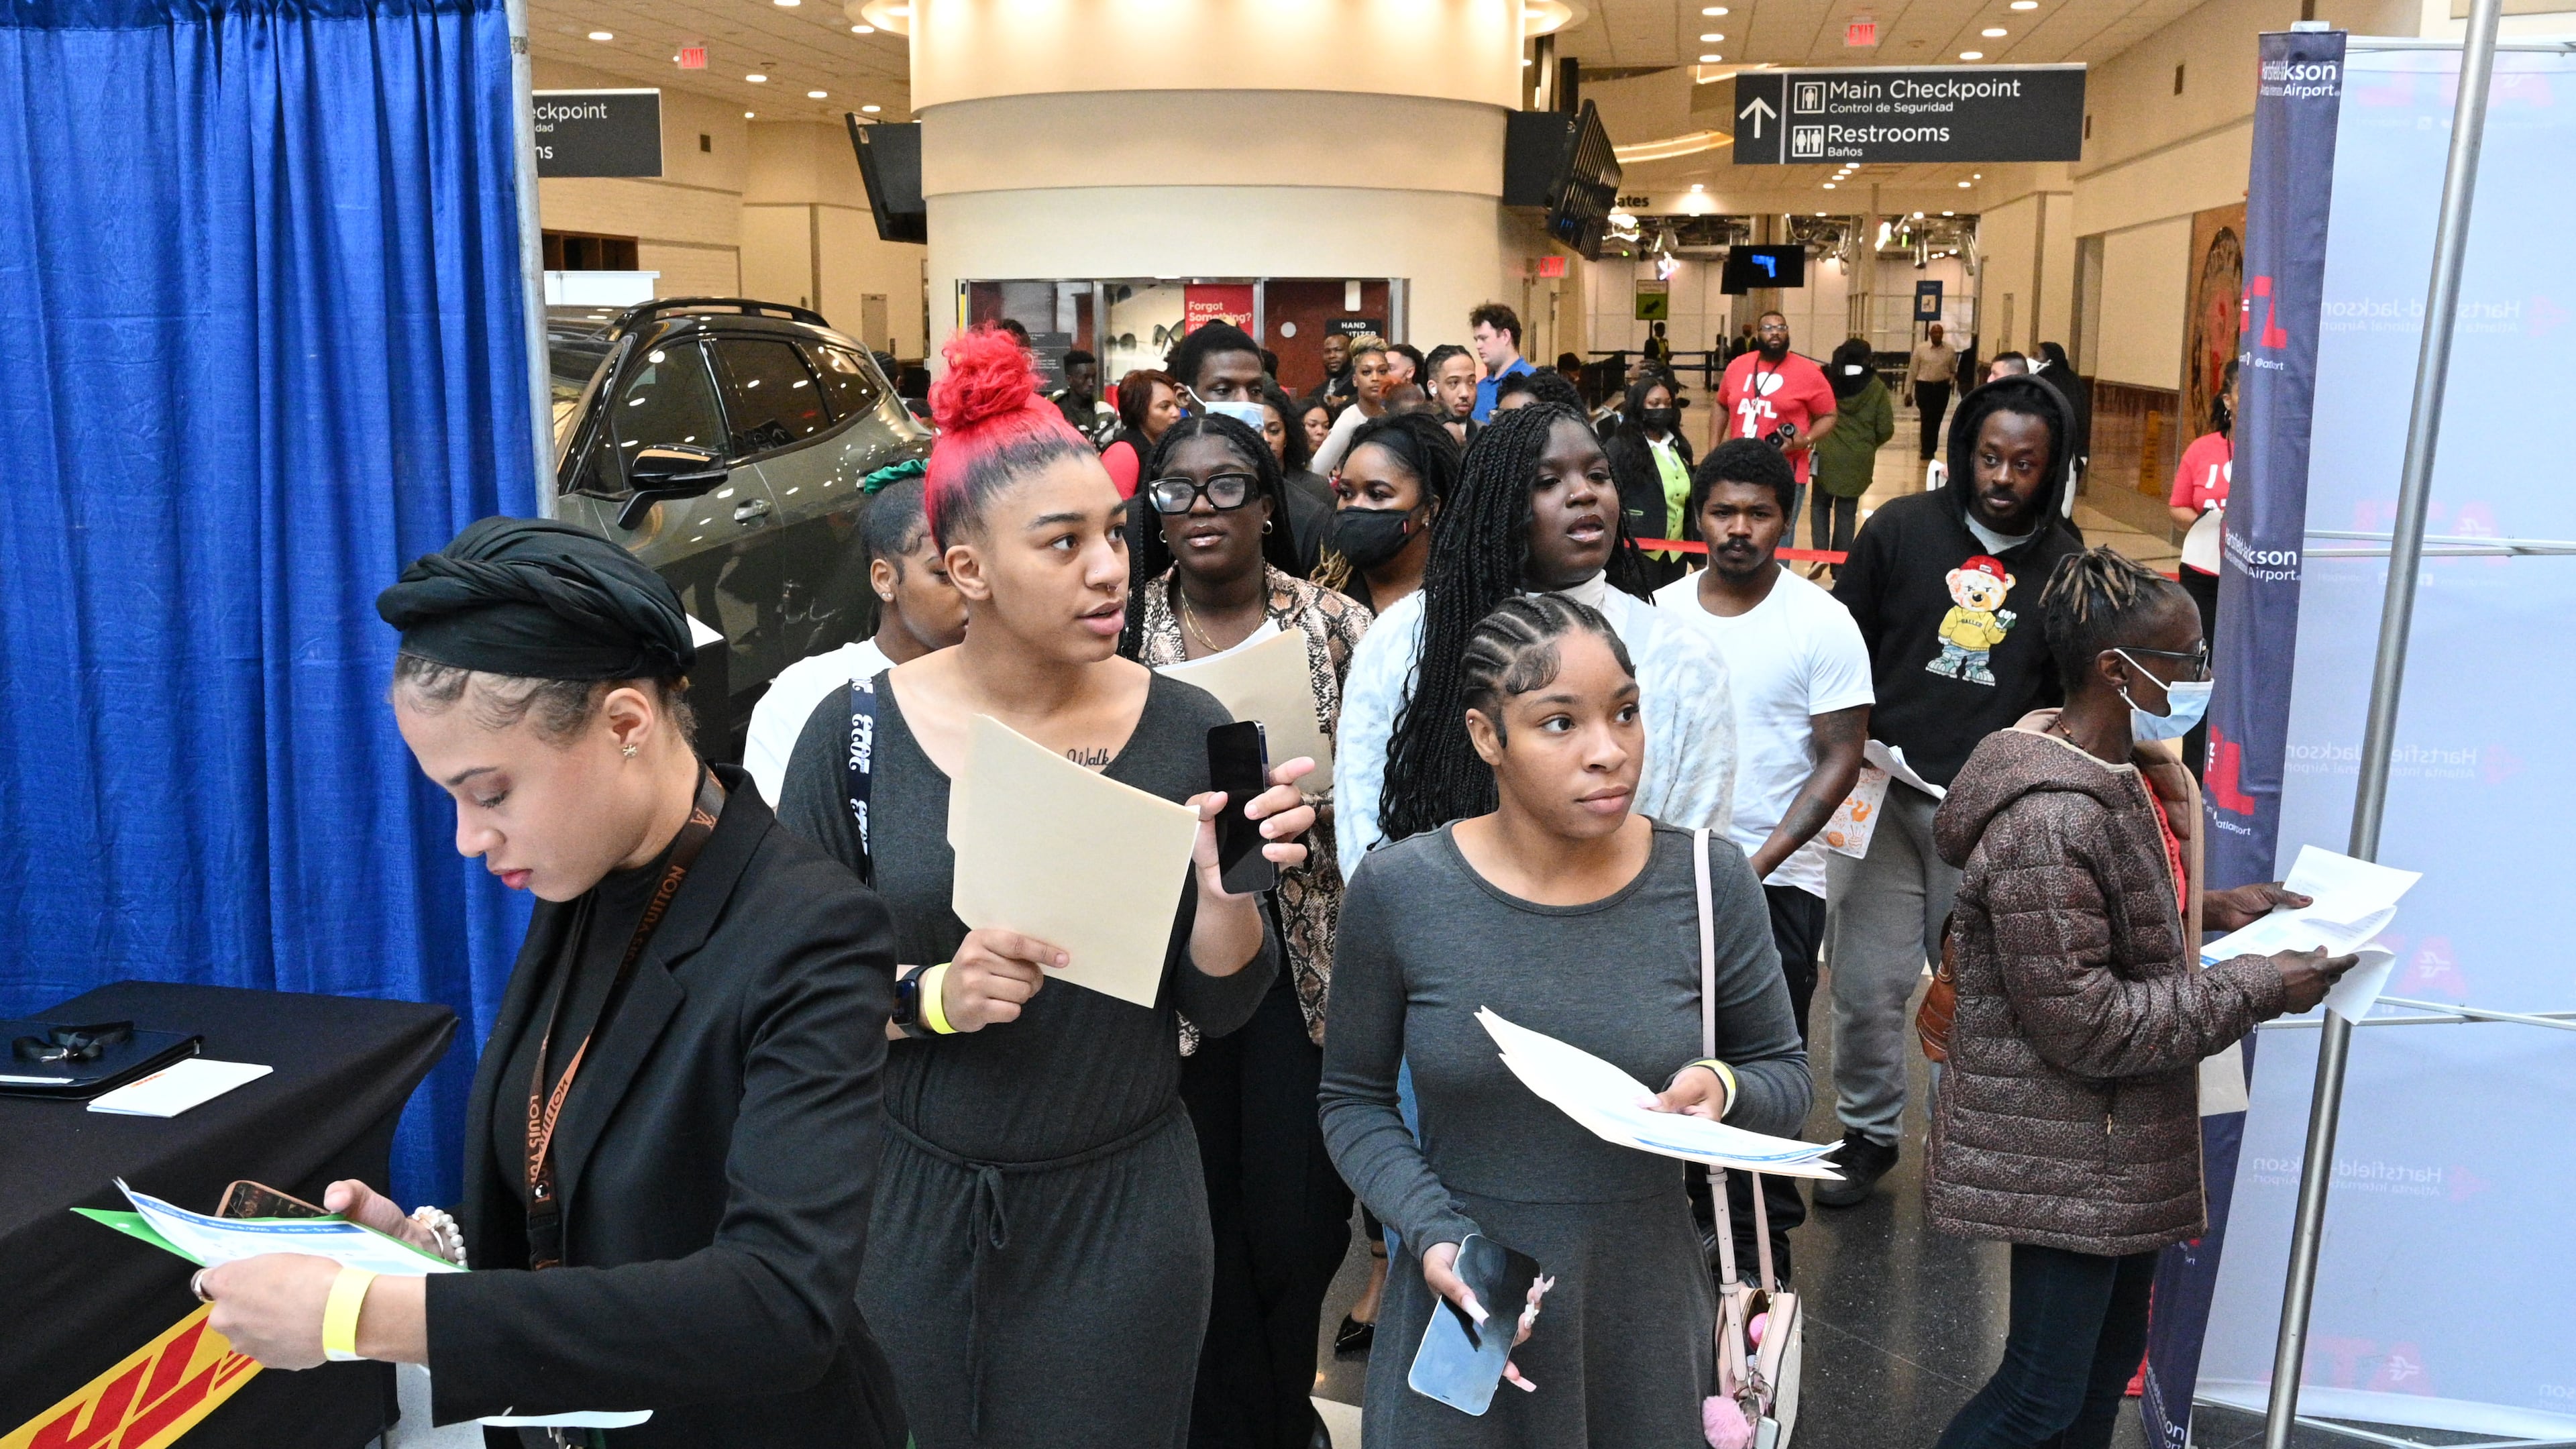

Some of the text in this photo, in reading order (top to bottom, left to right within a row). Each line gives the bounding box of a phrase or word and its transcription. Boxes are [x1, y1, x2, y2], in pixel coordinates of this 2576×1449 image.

[1849, 24, 1876, 45] EXIT
[682, 48, 704, 68] EXIT
[1829, 78, 2021, 101] Main Checkpoint
[1829, 102, 1953, 115] Control de Seguridad
[1828, 125, 1949, 144] Restrooms
[1827, 146, 1863, 157] Baños
[1189, 301, 1224, 313] Forgot
[1743, 374, 1754, 392] I
[2205, 464, 2218, 489] I
[849, 713, 873, 774] 2023
[1067, 747, 1109, 767] Walk
